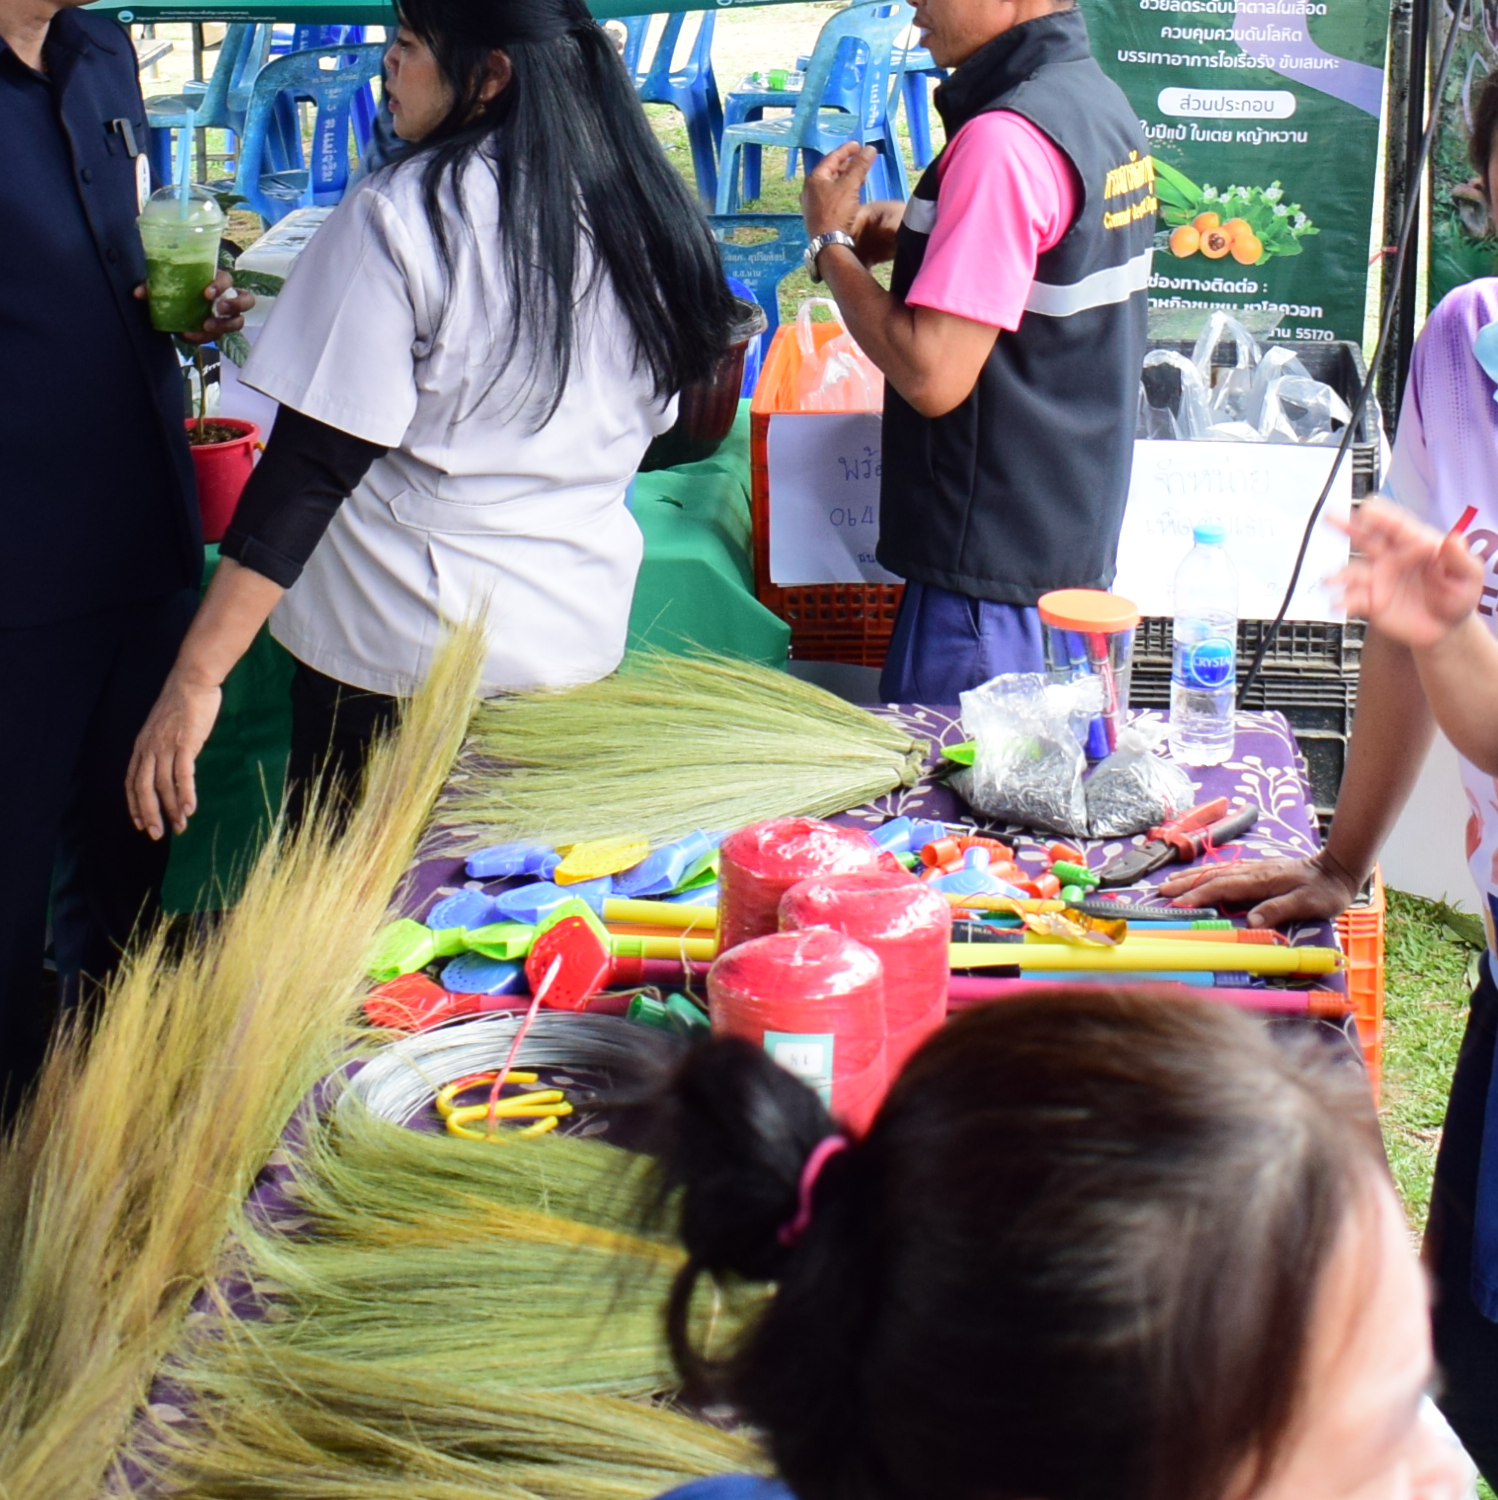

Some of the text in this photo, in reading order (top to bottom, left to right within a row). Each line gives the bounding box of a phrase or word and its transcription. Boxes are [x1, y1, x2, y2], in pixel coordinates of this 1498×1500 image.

[1116, 49, 1340, 71] บรรเทาอาการไอเรื้อรัง ขับเสมหะ
[1178, 94, 1276, 114] ส่วนประกอบ
[1190, 123, 1233, 143] ใบเตย
[1235, 125, 1309, 146] หญ้าหวาน
[1149, 273, 1259, 295] ช่องทางติดต่อ
[1295, 327, 1335, 342] 55170
[1193, 655, 1232, 669] CRYSTA
